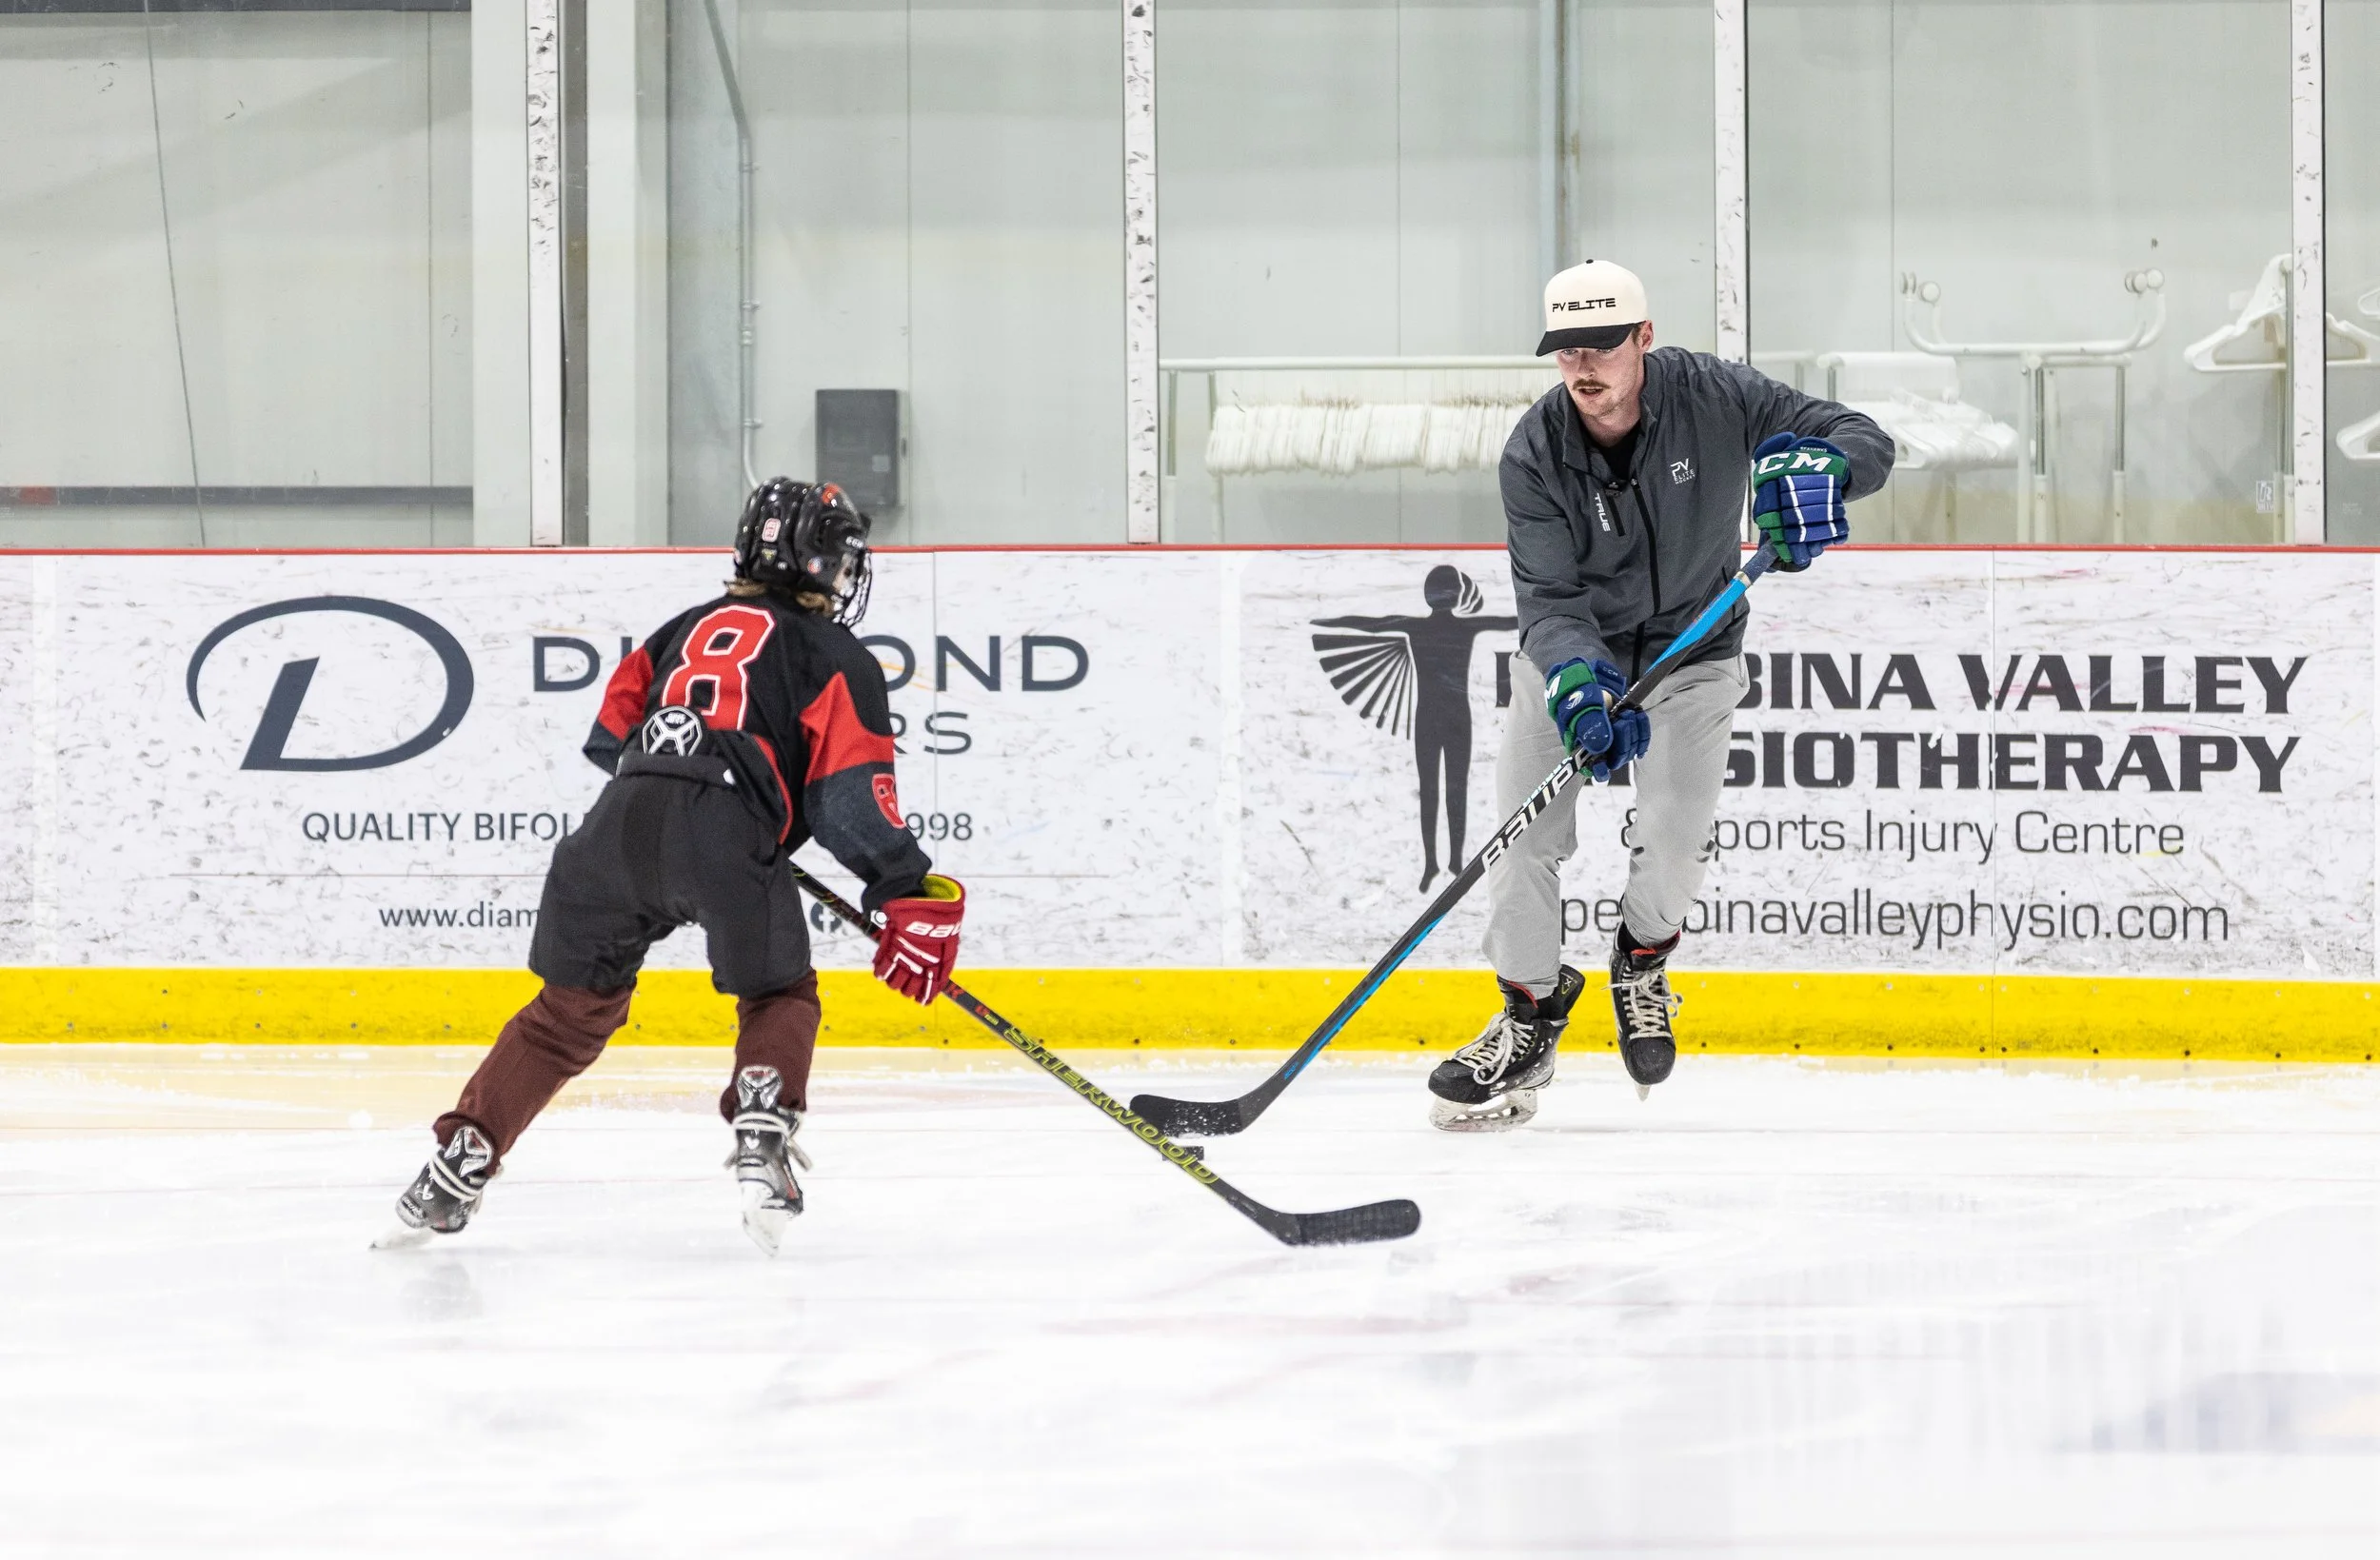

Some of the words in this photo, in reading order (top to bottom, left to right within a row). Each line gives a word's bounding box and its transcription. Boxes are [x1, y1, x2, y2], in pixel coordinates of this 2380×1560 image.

[1552, 302, 1566, 312] PV
[1568, 298, 1616, 311] ELITE
[1757, 452, 1833, 475] CM
[1594, 492, 1611, 532] TRUE
[533, 634, 1089, 692] DOND
[660, 603, 778, 731] 8
[1958, 654, 2308, 714] VALLEY
[1584, 731, 2301, 793] SIOTHERAPY
[303, 813, 461, 842] QUALITY
[475, 813, 568, 840] BIFOL
[905, 812, 973, 840] 998
[1713, 814, 1845, 861] ports
[1866, 809, 1998, 865] Injury
[2015, 810, 2184, 855] Centre
[379, 900, 540, 928] www.diam
[1560, 887, 2229, 952] pebinavalleyphysio.com
[1002, 1025, 1220, 1185] SHERWOOD
